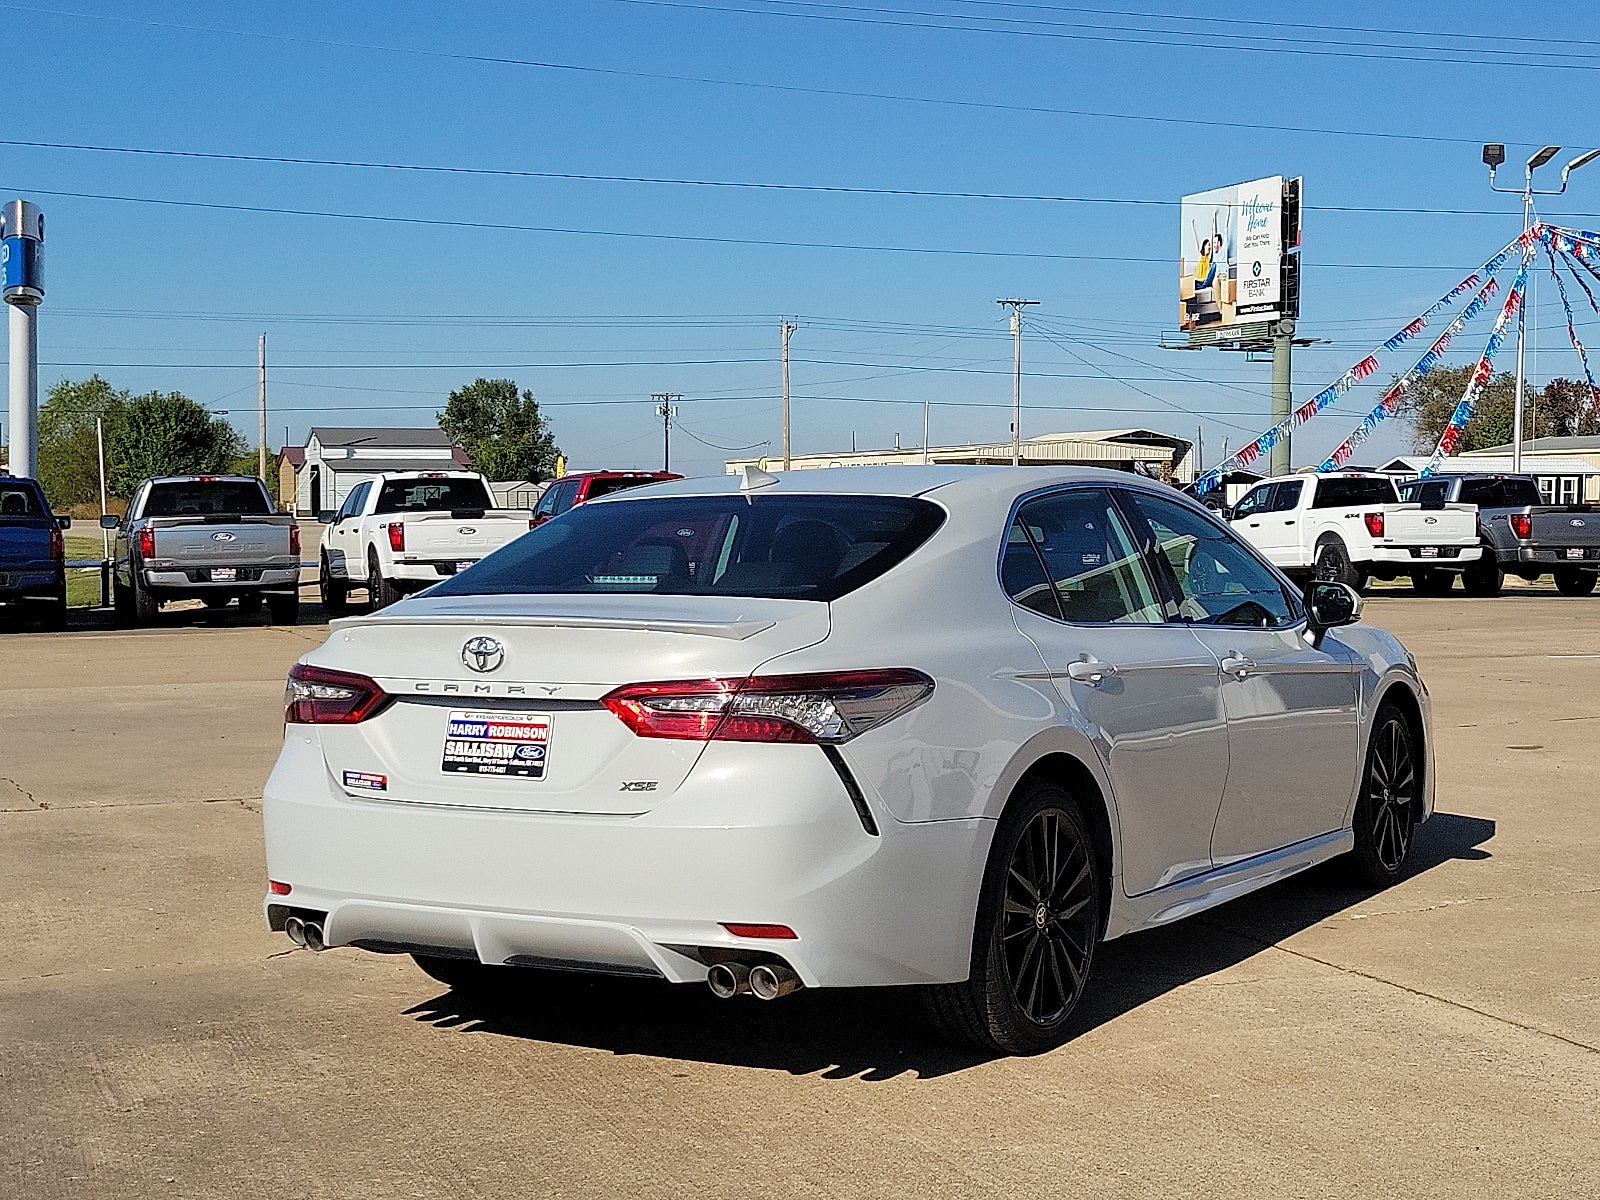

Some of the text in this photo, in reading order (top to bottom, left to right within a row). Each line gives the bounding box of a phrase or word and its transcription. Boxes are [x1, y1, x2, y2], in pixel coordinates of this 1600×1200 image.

[1242, 194, 1274, 216] Welcome
[1247, 214, 1268, 232] Home
[1243, 278, 1270, 289] FIRSTAR
[1248, 289, 1265, 298] BANK
[415, 682, 562, 695] CAMRY
[448, 723, 548, 740] HARRY ROBINSON
[445, 741, 518, 759] SALLISAW
[619, 781, 659, 791] XSE
